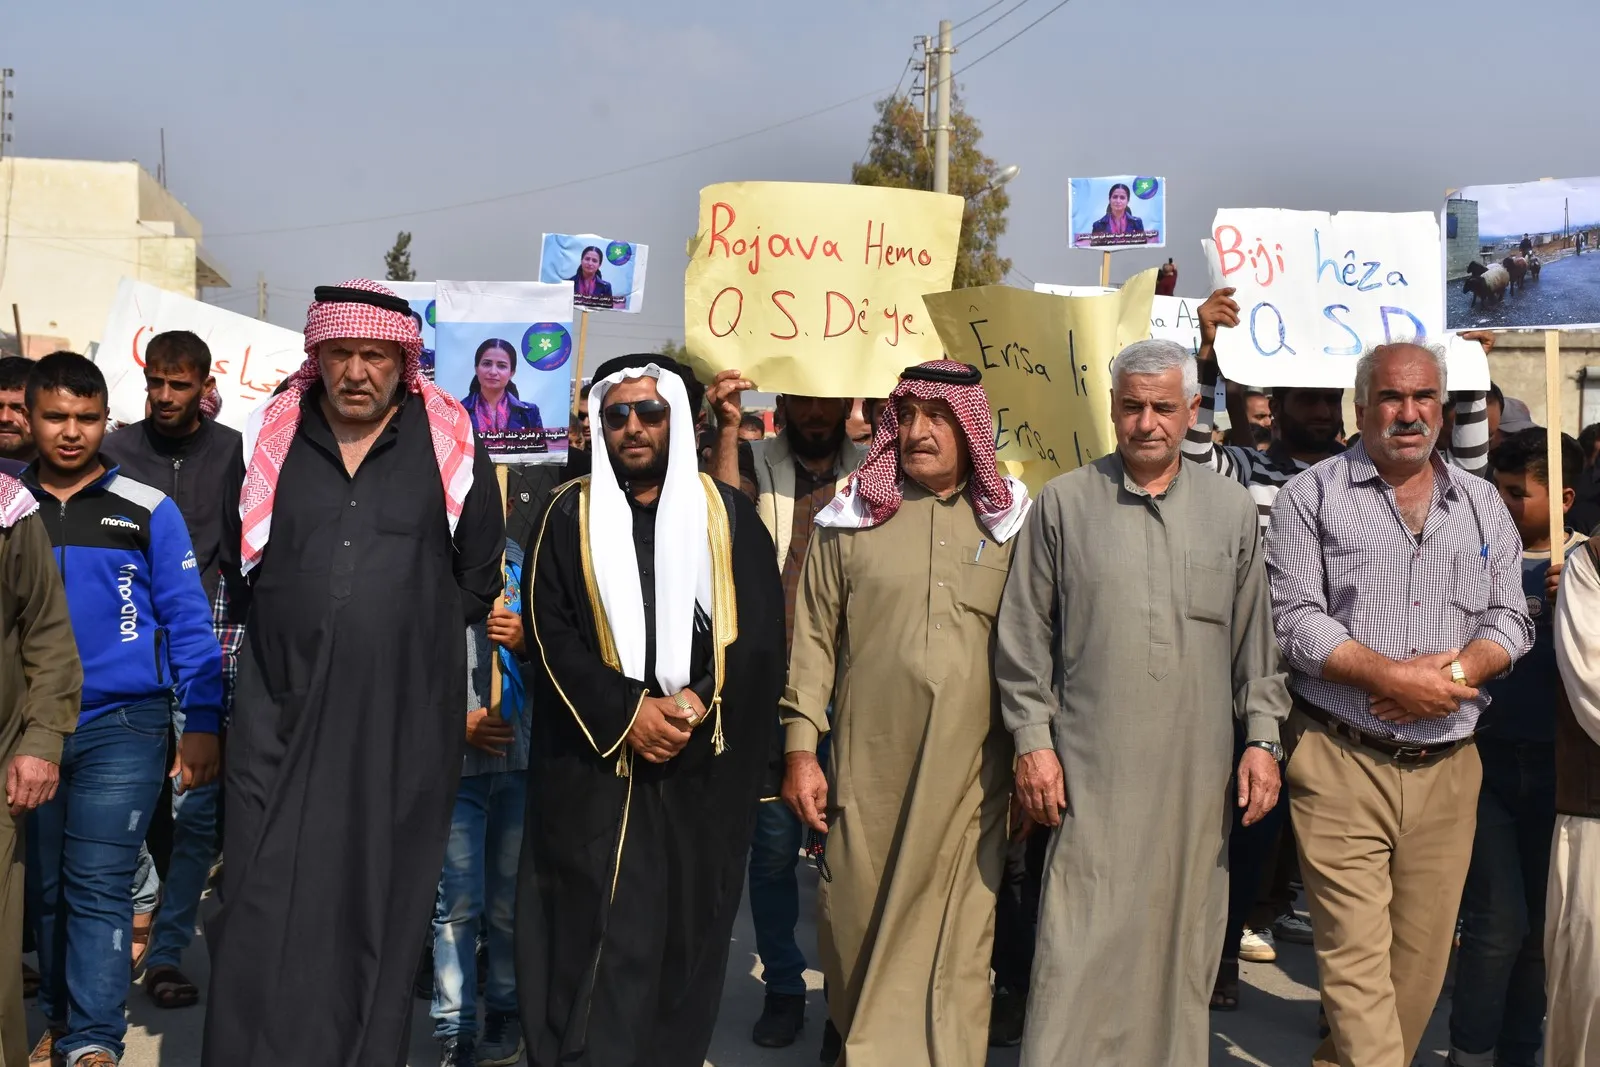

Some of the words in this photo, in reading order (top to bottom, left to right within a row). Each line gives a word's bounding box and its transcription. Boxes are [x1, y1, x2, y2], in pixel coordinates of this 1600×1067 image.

[708, 202, 843, 275] Rojava
[865, 220, 932, 270] Hemo
[1314, 228, 1409, 292] hêza
[1069, 329, 1088, 397] li
[100, 516, 140, 531] maraton
